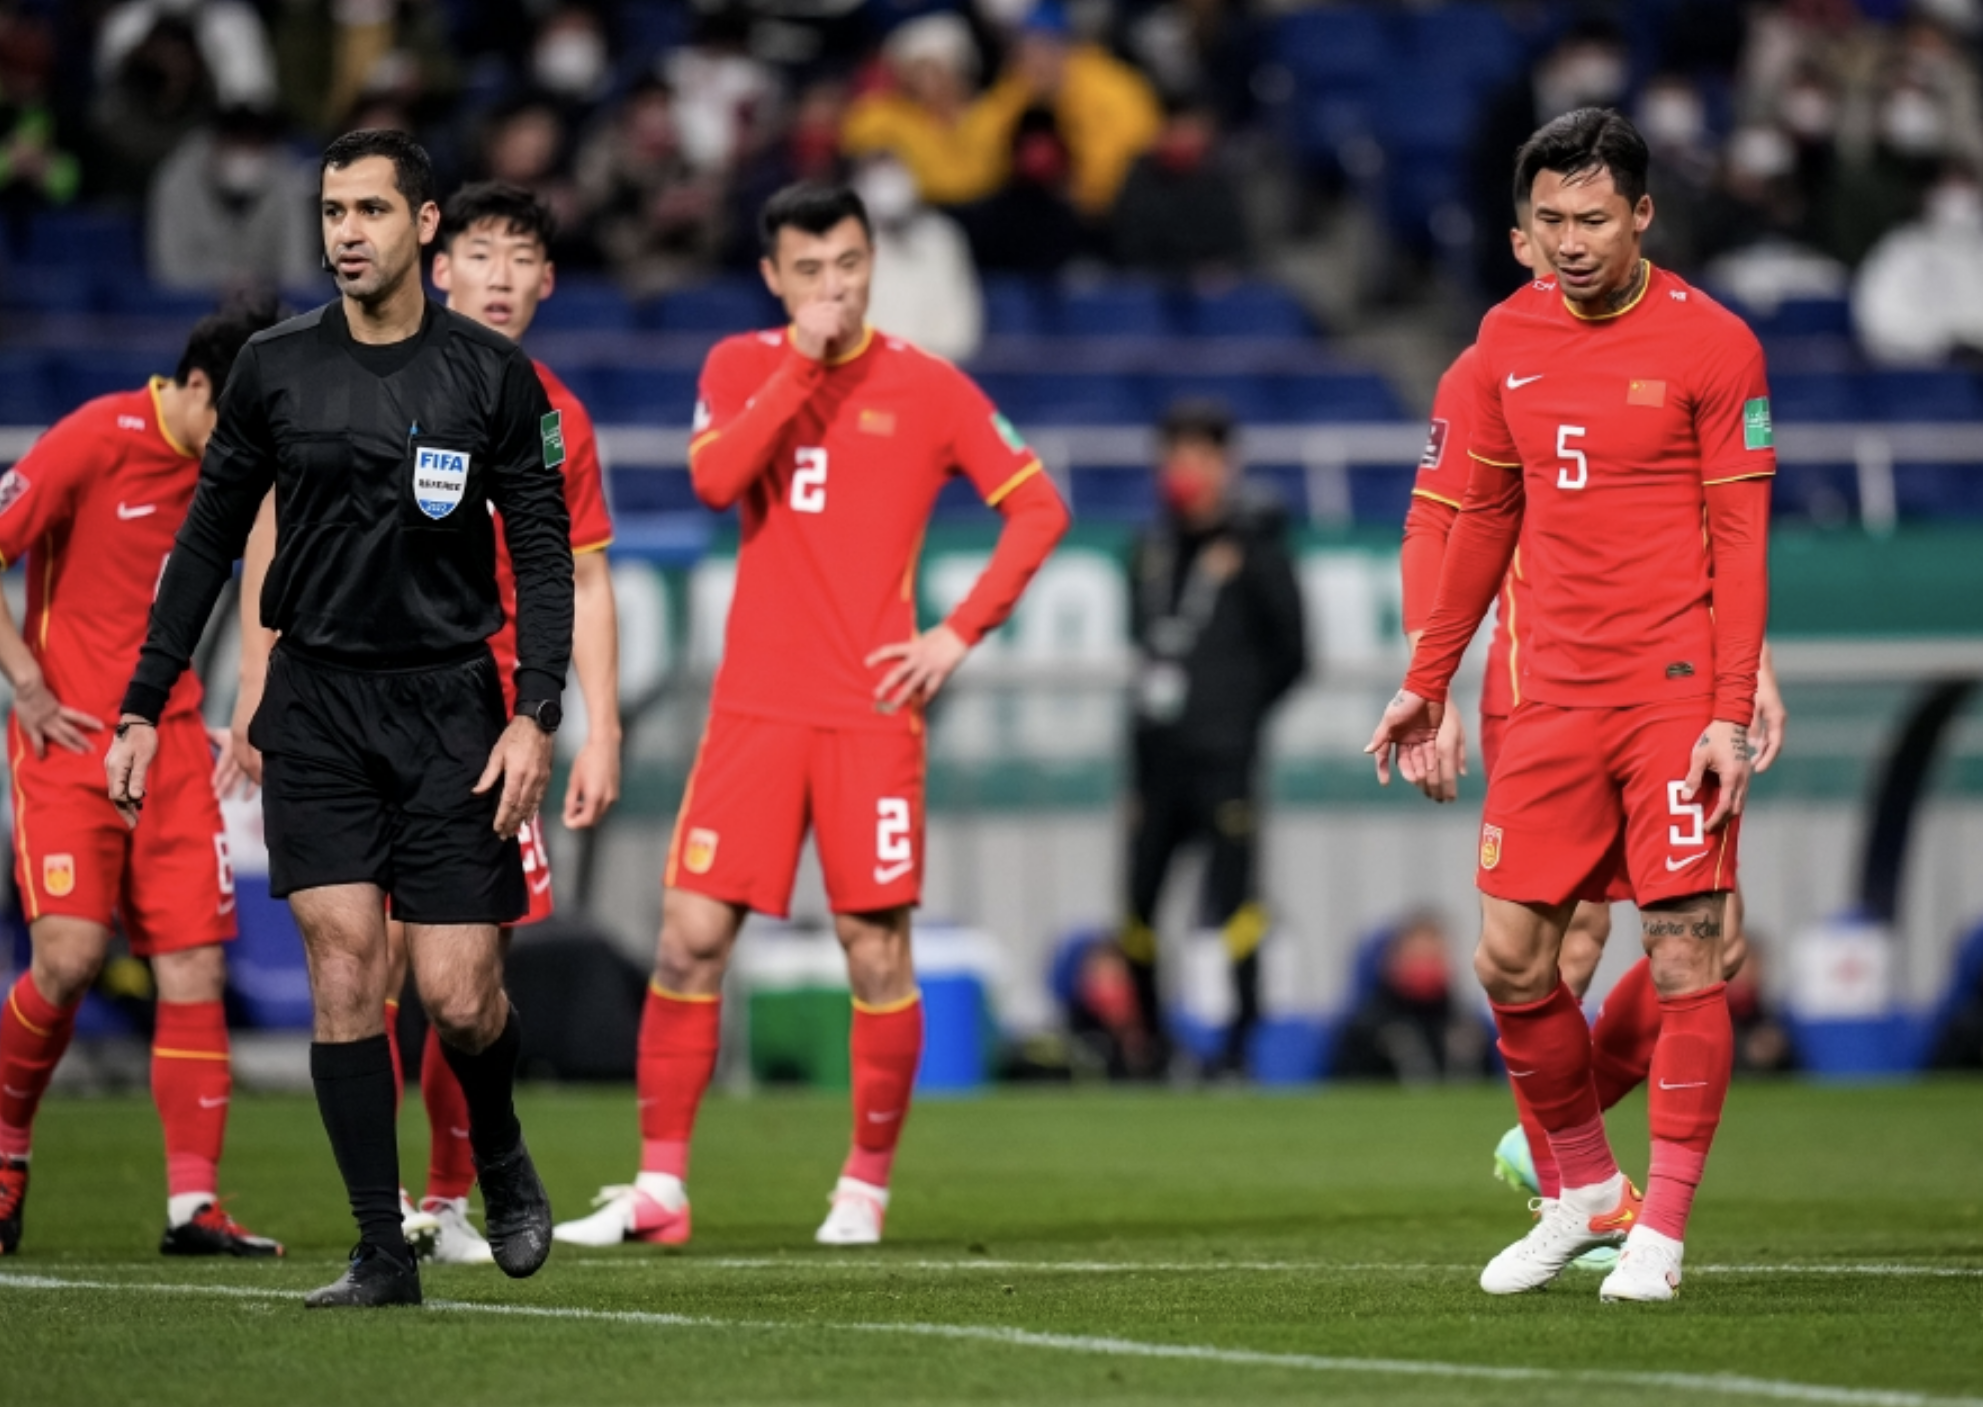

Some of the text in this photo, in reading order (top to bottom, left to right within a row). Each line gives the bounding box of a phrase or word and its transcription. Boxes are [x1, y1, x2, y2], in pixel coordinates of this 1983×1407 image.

[421, 452, 463, 473] FIFA
[790, 446, 828, 513] 2
[1557, 424, 1587, 489] 5
[877, 797, 911, 861] 2
[1667, 780, 1704, 845] 5
